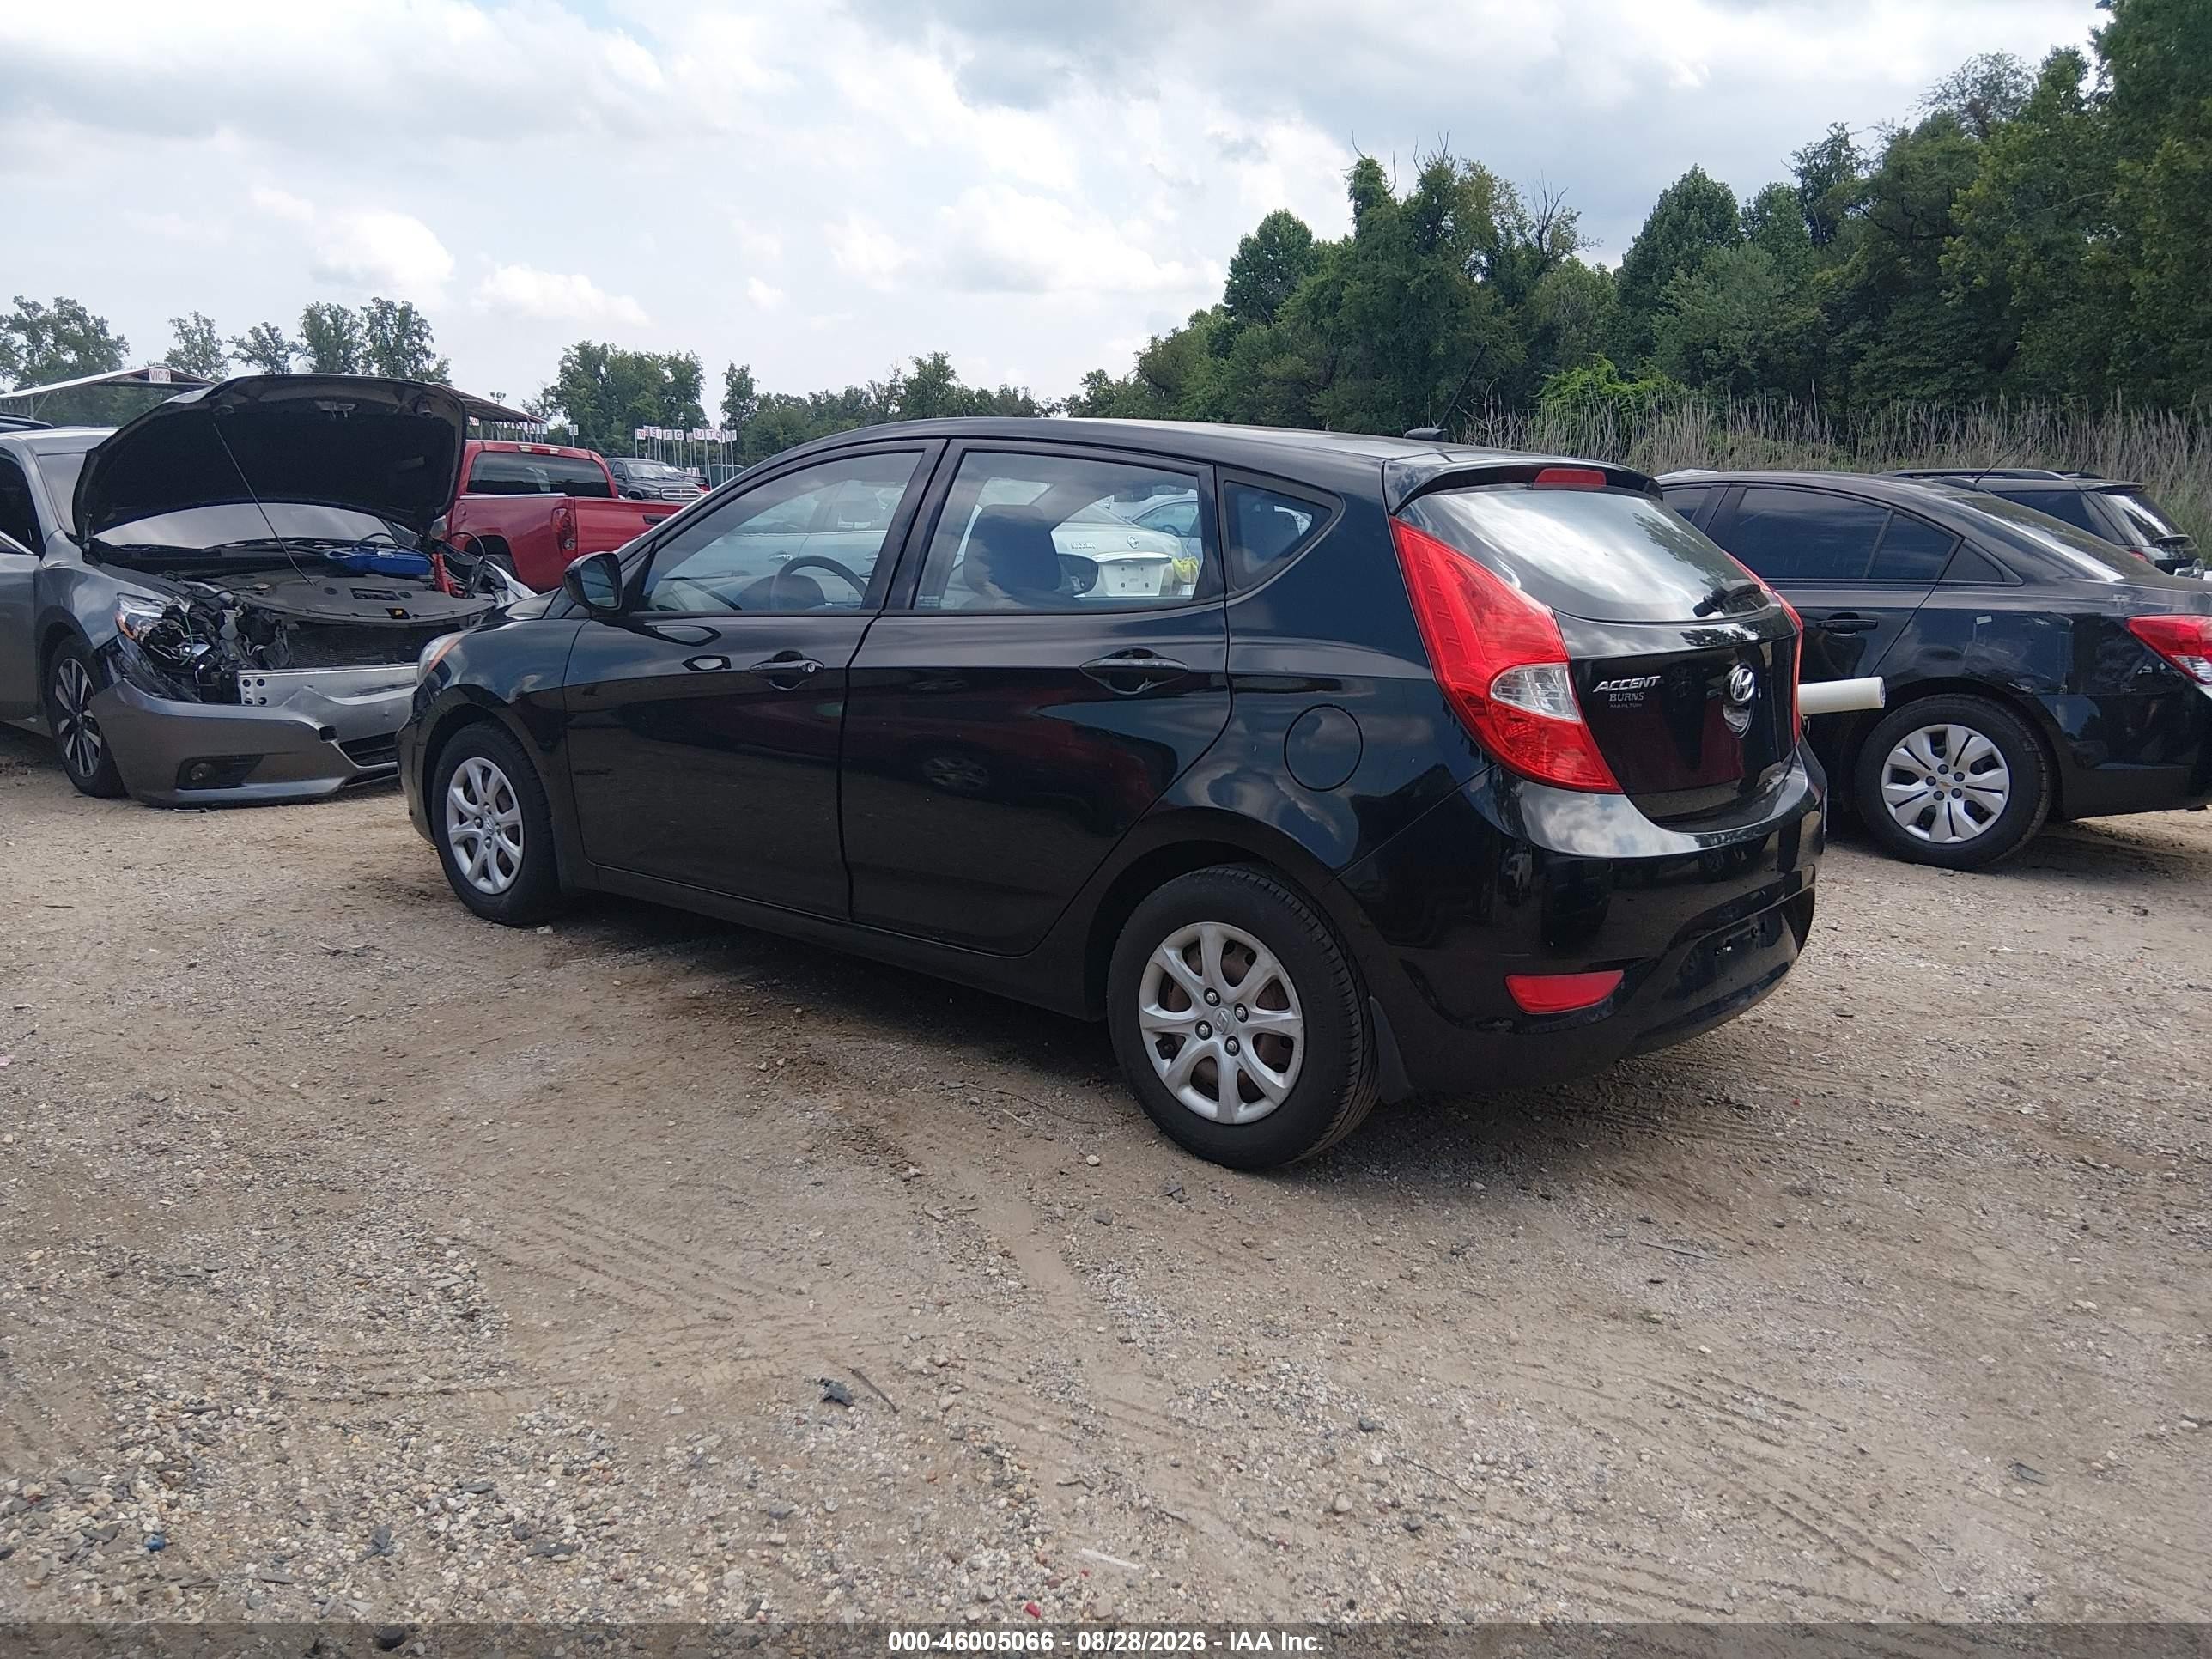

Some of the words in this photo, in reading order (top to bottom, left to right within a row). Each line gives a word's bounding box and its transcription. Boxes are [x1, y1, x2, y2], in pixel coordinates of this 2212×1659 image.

[150, 371, 163, 380] VIC
[165, 371, 169, 381] 2
[676, 430, 683, 439] G
[1592, 675, 1661, 693] ACCENT
[1608, 692, 1644, 702] BURNS
